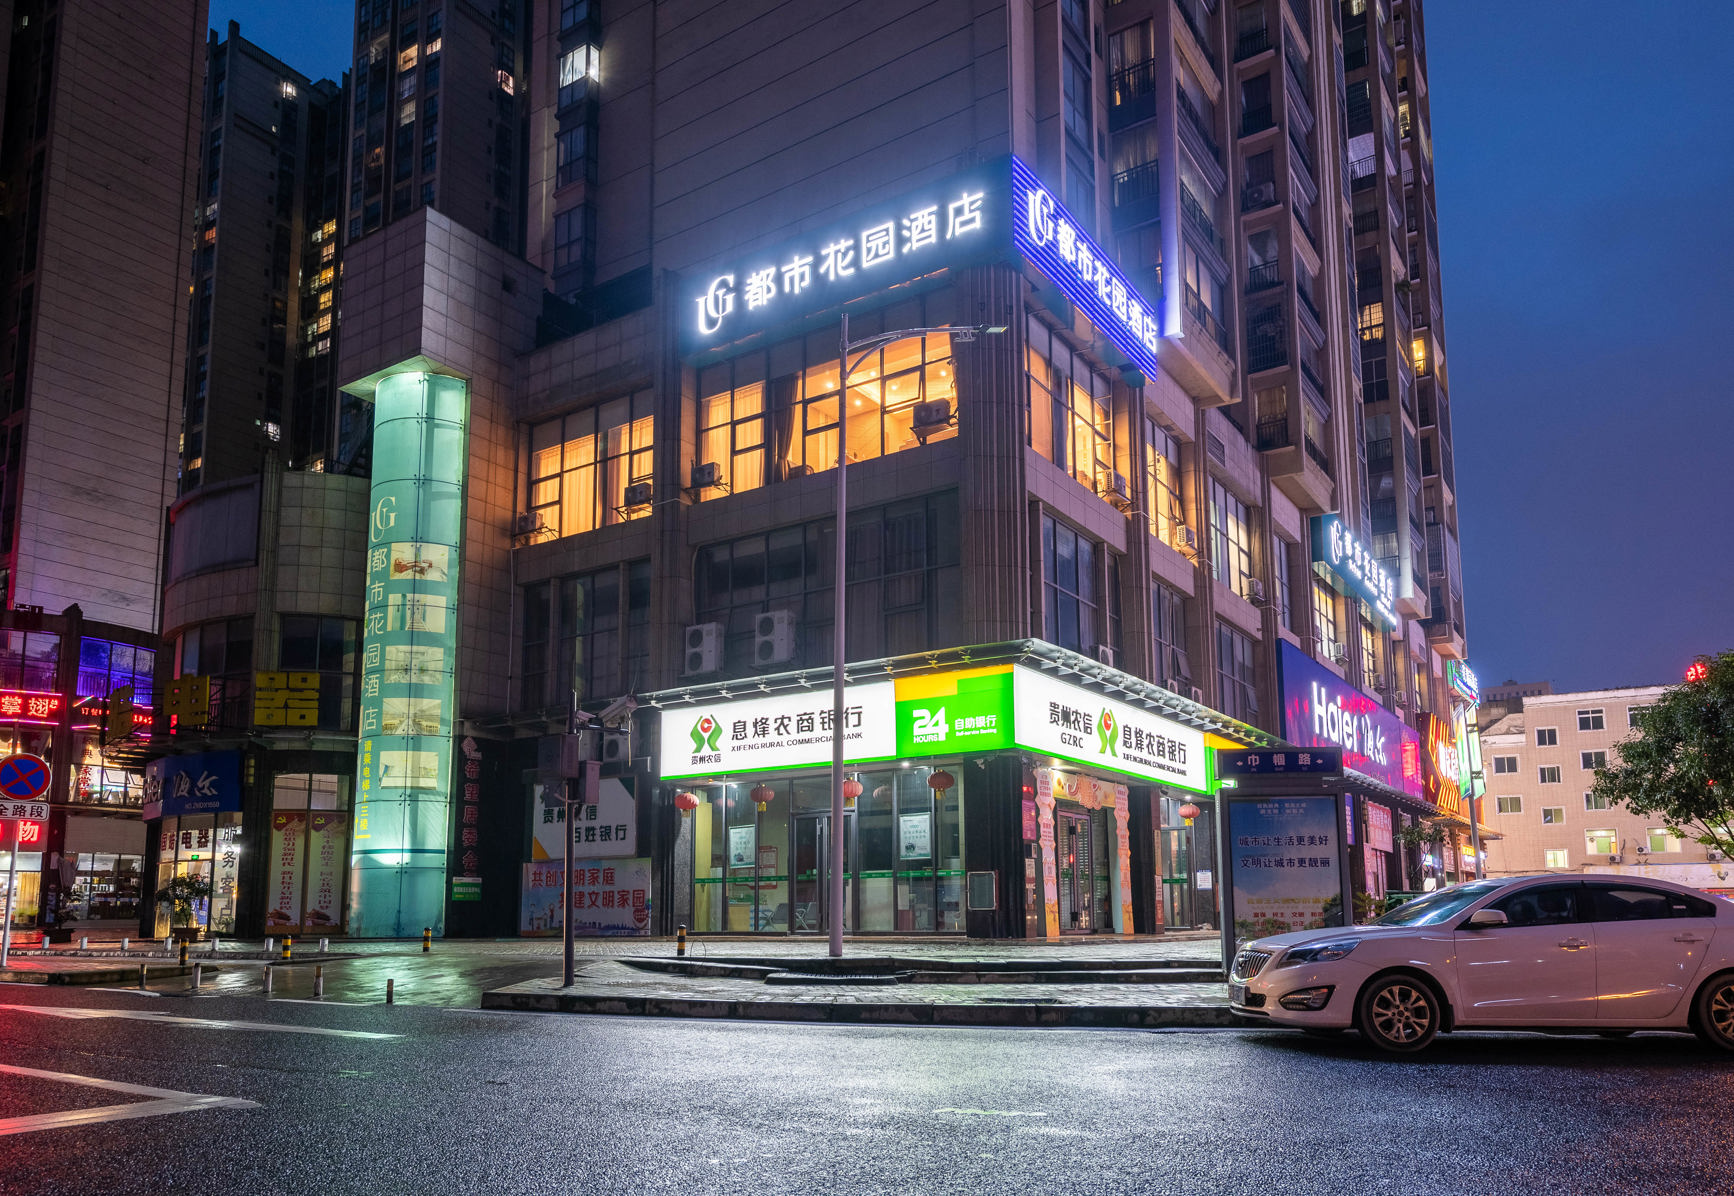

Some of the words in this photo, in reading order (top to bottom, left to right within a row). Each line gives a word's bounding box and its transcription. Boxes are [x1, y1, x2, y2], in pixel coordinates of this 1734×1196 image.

[744, 192, 984, 311] 都市花园酒店
[1057, 218, 1157, 353] 都市花园酒店
[363, 548, 386, 731] 都市花园酒店
[732, 706, 862, 741] 息烽农商银行
[913, 706, 949, 741] 24
[955, 715, 997, 730] 自助银行
[1049, 701, 1092, 735] 贵州农信
[1312, 681, 1358, 753] Haier
[731, 742, 760, 751] XIFENG
[760, 740, 785, 749] RURAL
[787, 735, 836, 747] COMMERCIA
[913, 734, 938, 743] HOURS
[1061, 733, 1083, 749] GZRC
[1122, 724, 1186, 764] 息烽农商银行
[1247, 753, 1311, 767] 巾帼路
[573, 824, 627, 843] 百姓银行
[1239, 836, 1329, 847] 城市让生活更美好
[1240, 857, 1331, 869] 文明让城市更靓丽
